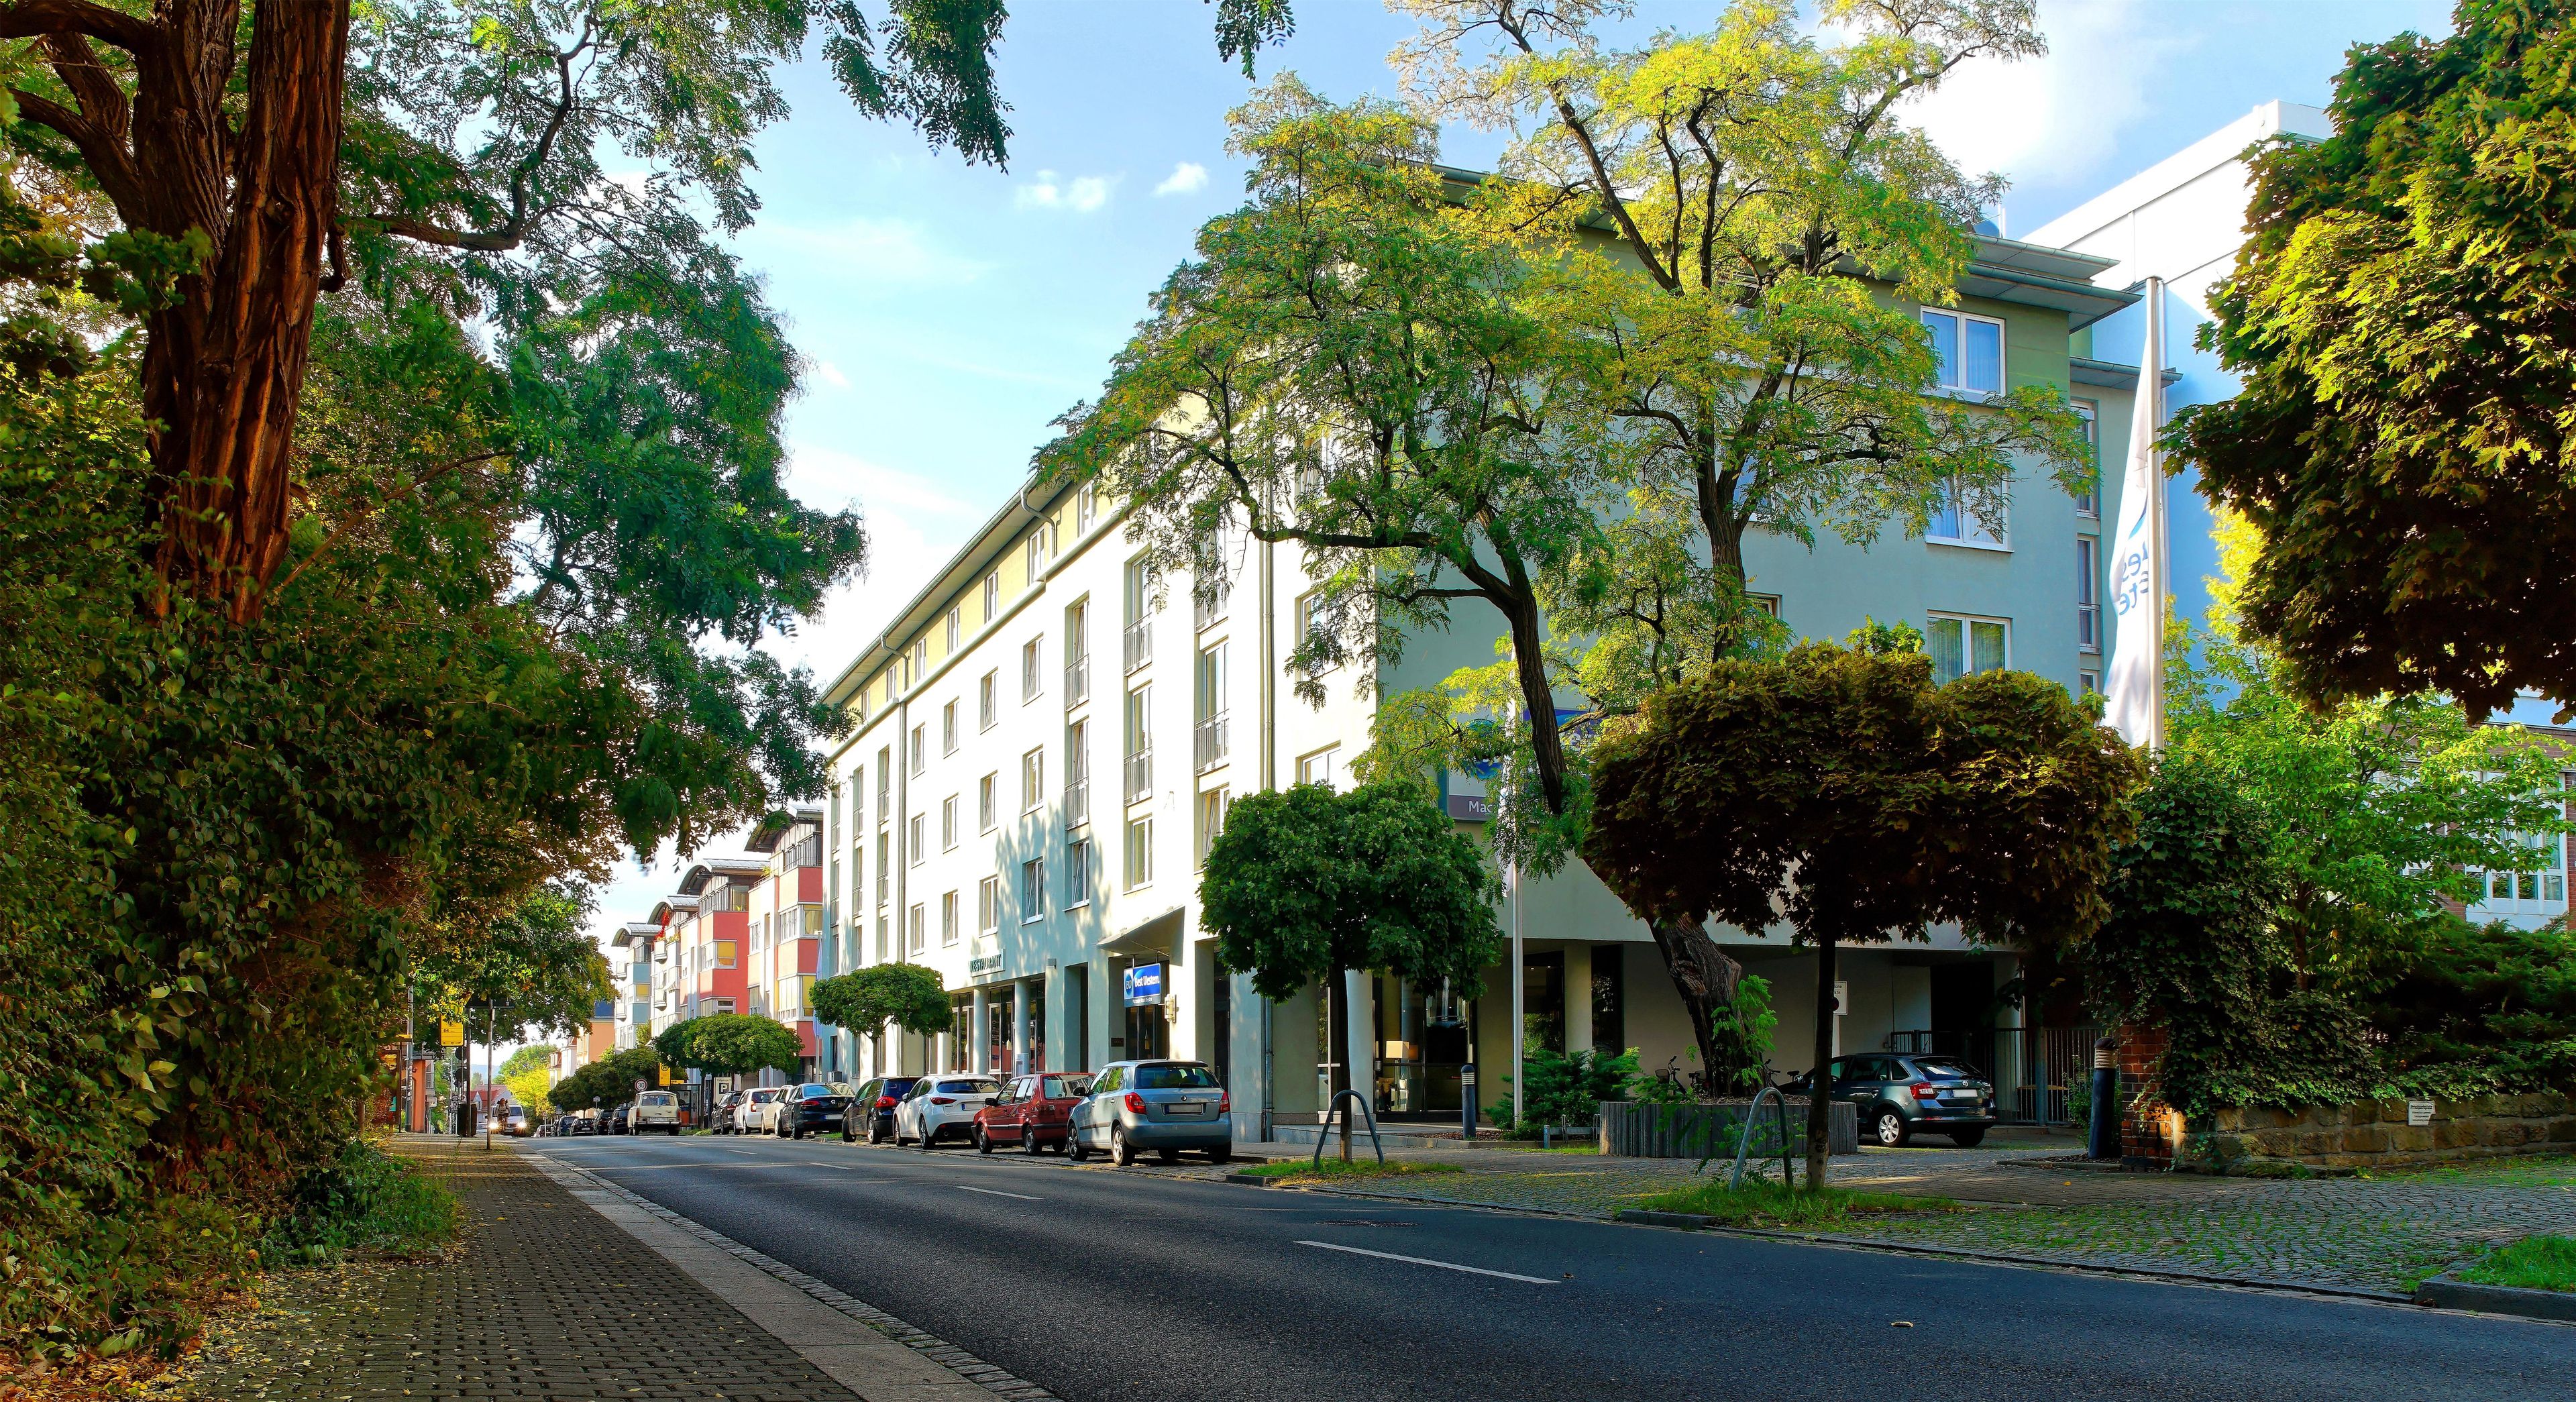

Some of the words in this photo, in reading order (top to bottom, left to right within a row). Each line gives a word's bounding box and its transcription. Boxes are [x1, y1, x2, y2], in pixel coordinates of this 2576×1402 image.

[1468, 800, 1494, 814] Mac
[970, 954, 1002, 973] RESTAURANT
[1134, 977, 1143, 987] Best
[720, 1083, 728, 1093] P
